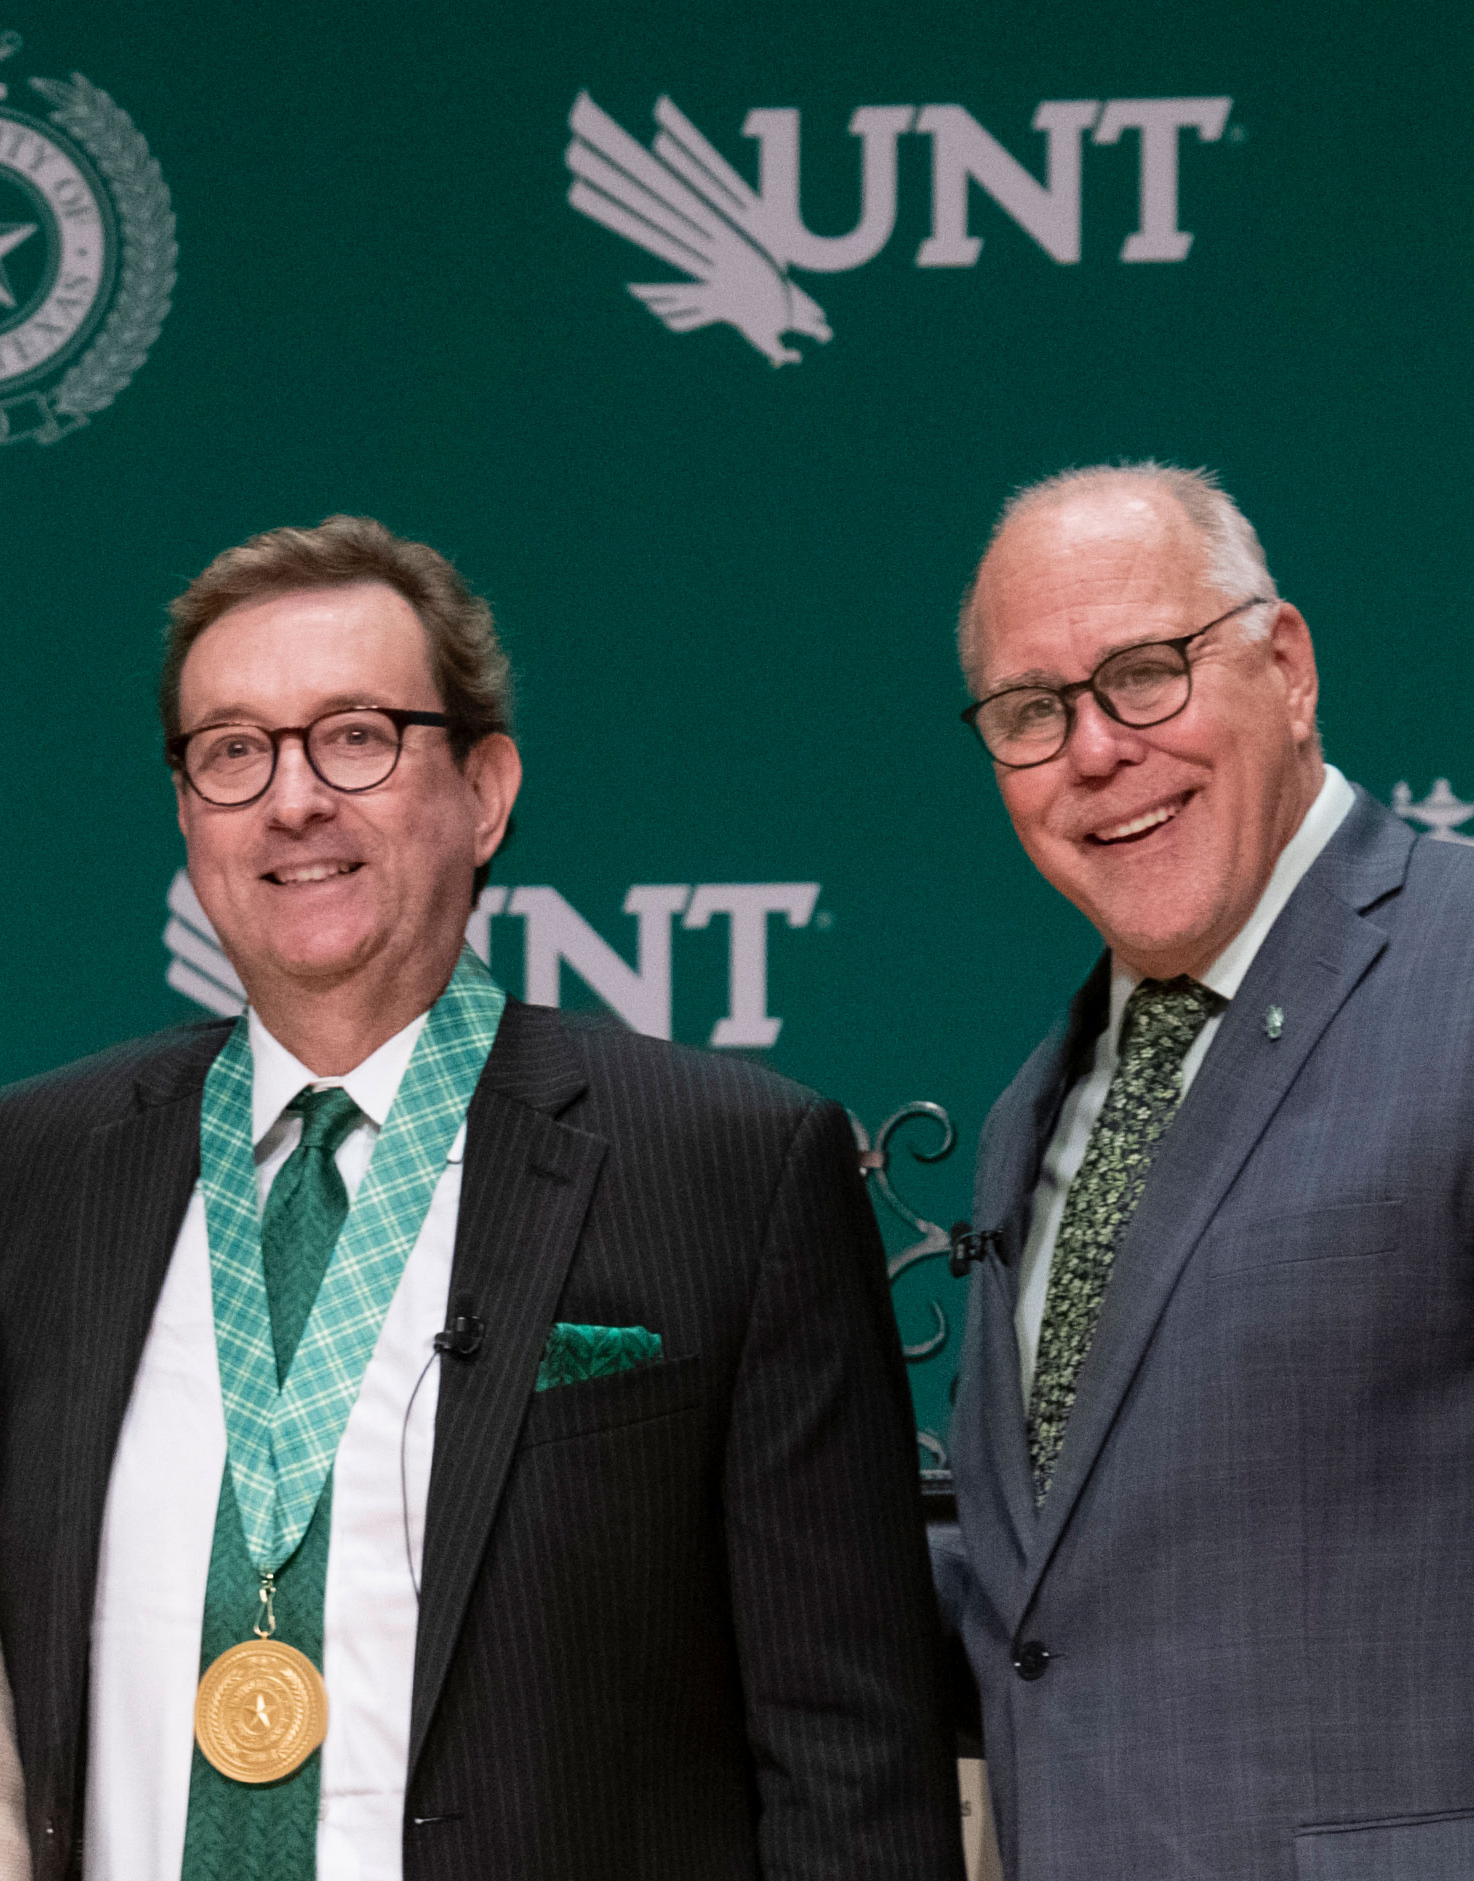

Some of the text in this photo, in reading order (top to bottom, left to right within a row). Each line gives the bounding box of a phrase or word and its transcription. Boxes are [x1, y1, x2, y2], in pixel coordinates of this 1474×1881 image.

[53, 177, 93, 223] OF
[740, 97, 1232, 273] UNT
[465, 882, 821, 1048] NT
